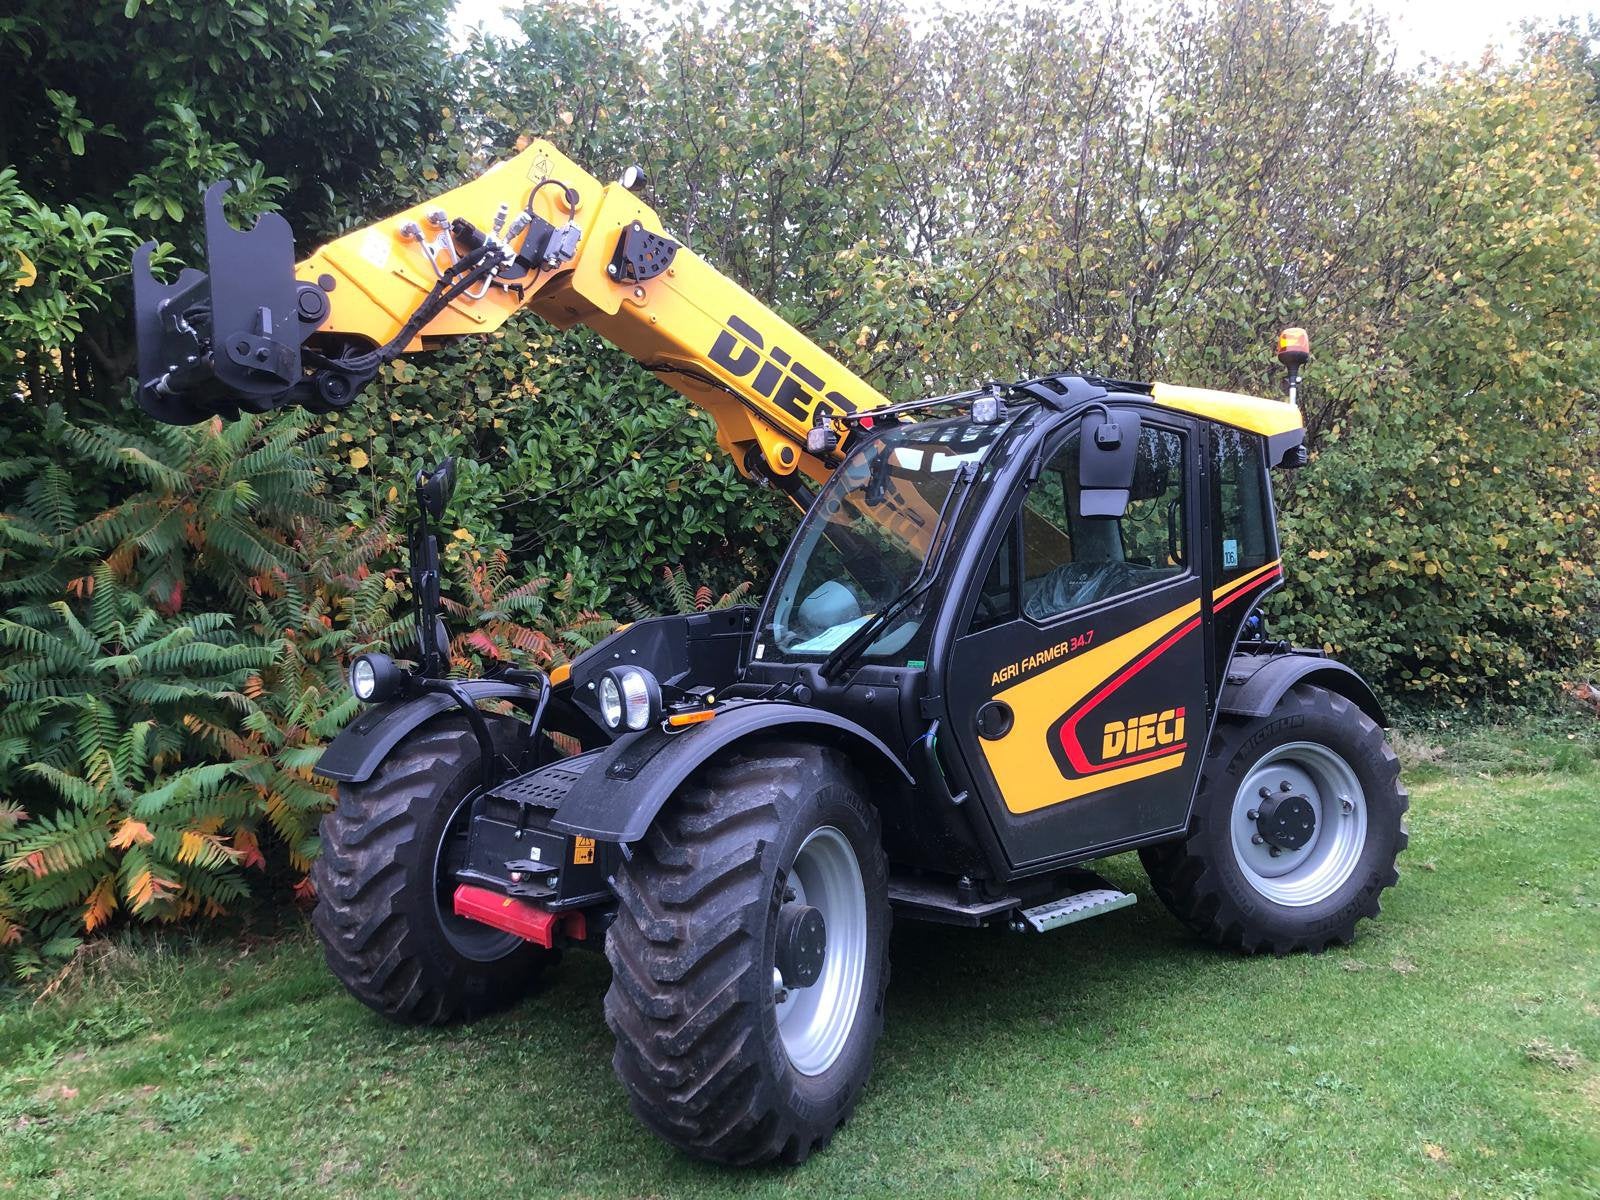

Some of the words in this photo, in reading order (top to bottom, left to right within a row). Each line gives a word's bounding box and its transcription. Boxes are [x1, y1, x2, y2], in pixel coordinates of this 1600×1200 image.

[991, 662, 1019, 686] AGRI
[1021, 641, 1069, 673] FARMER
[1070, 629, 1094, 651] 34.7
